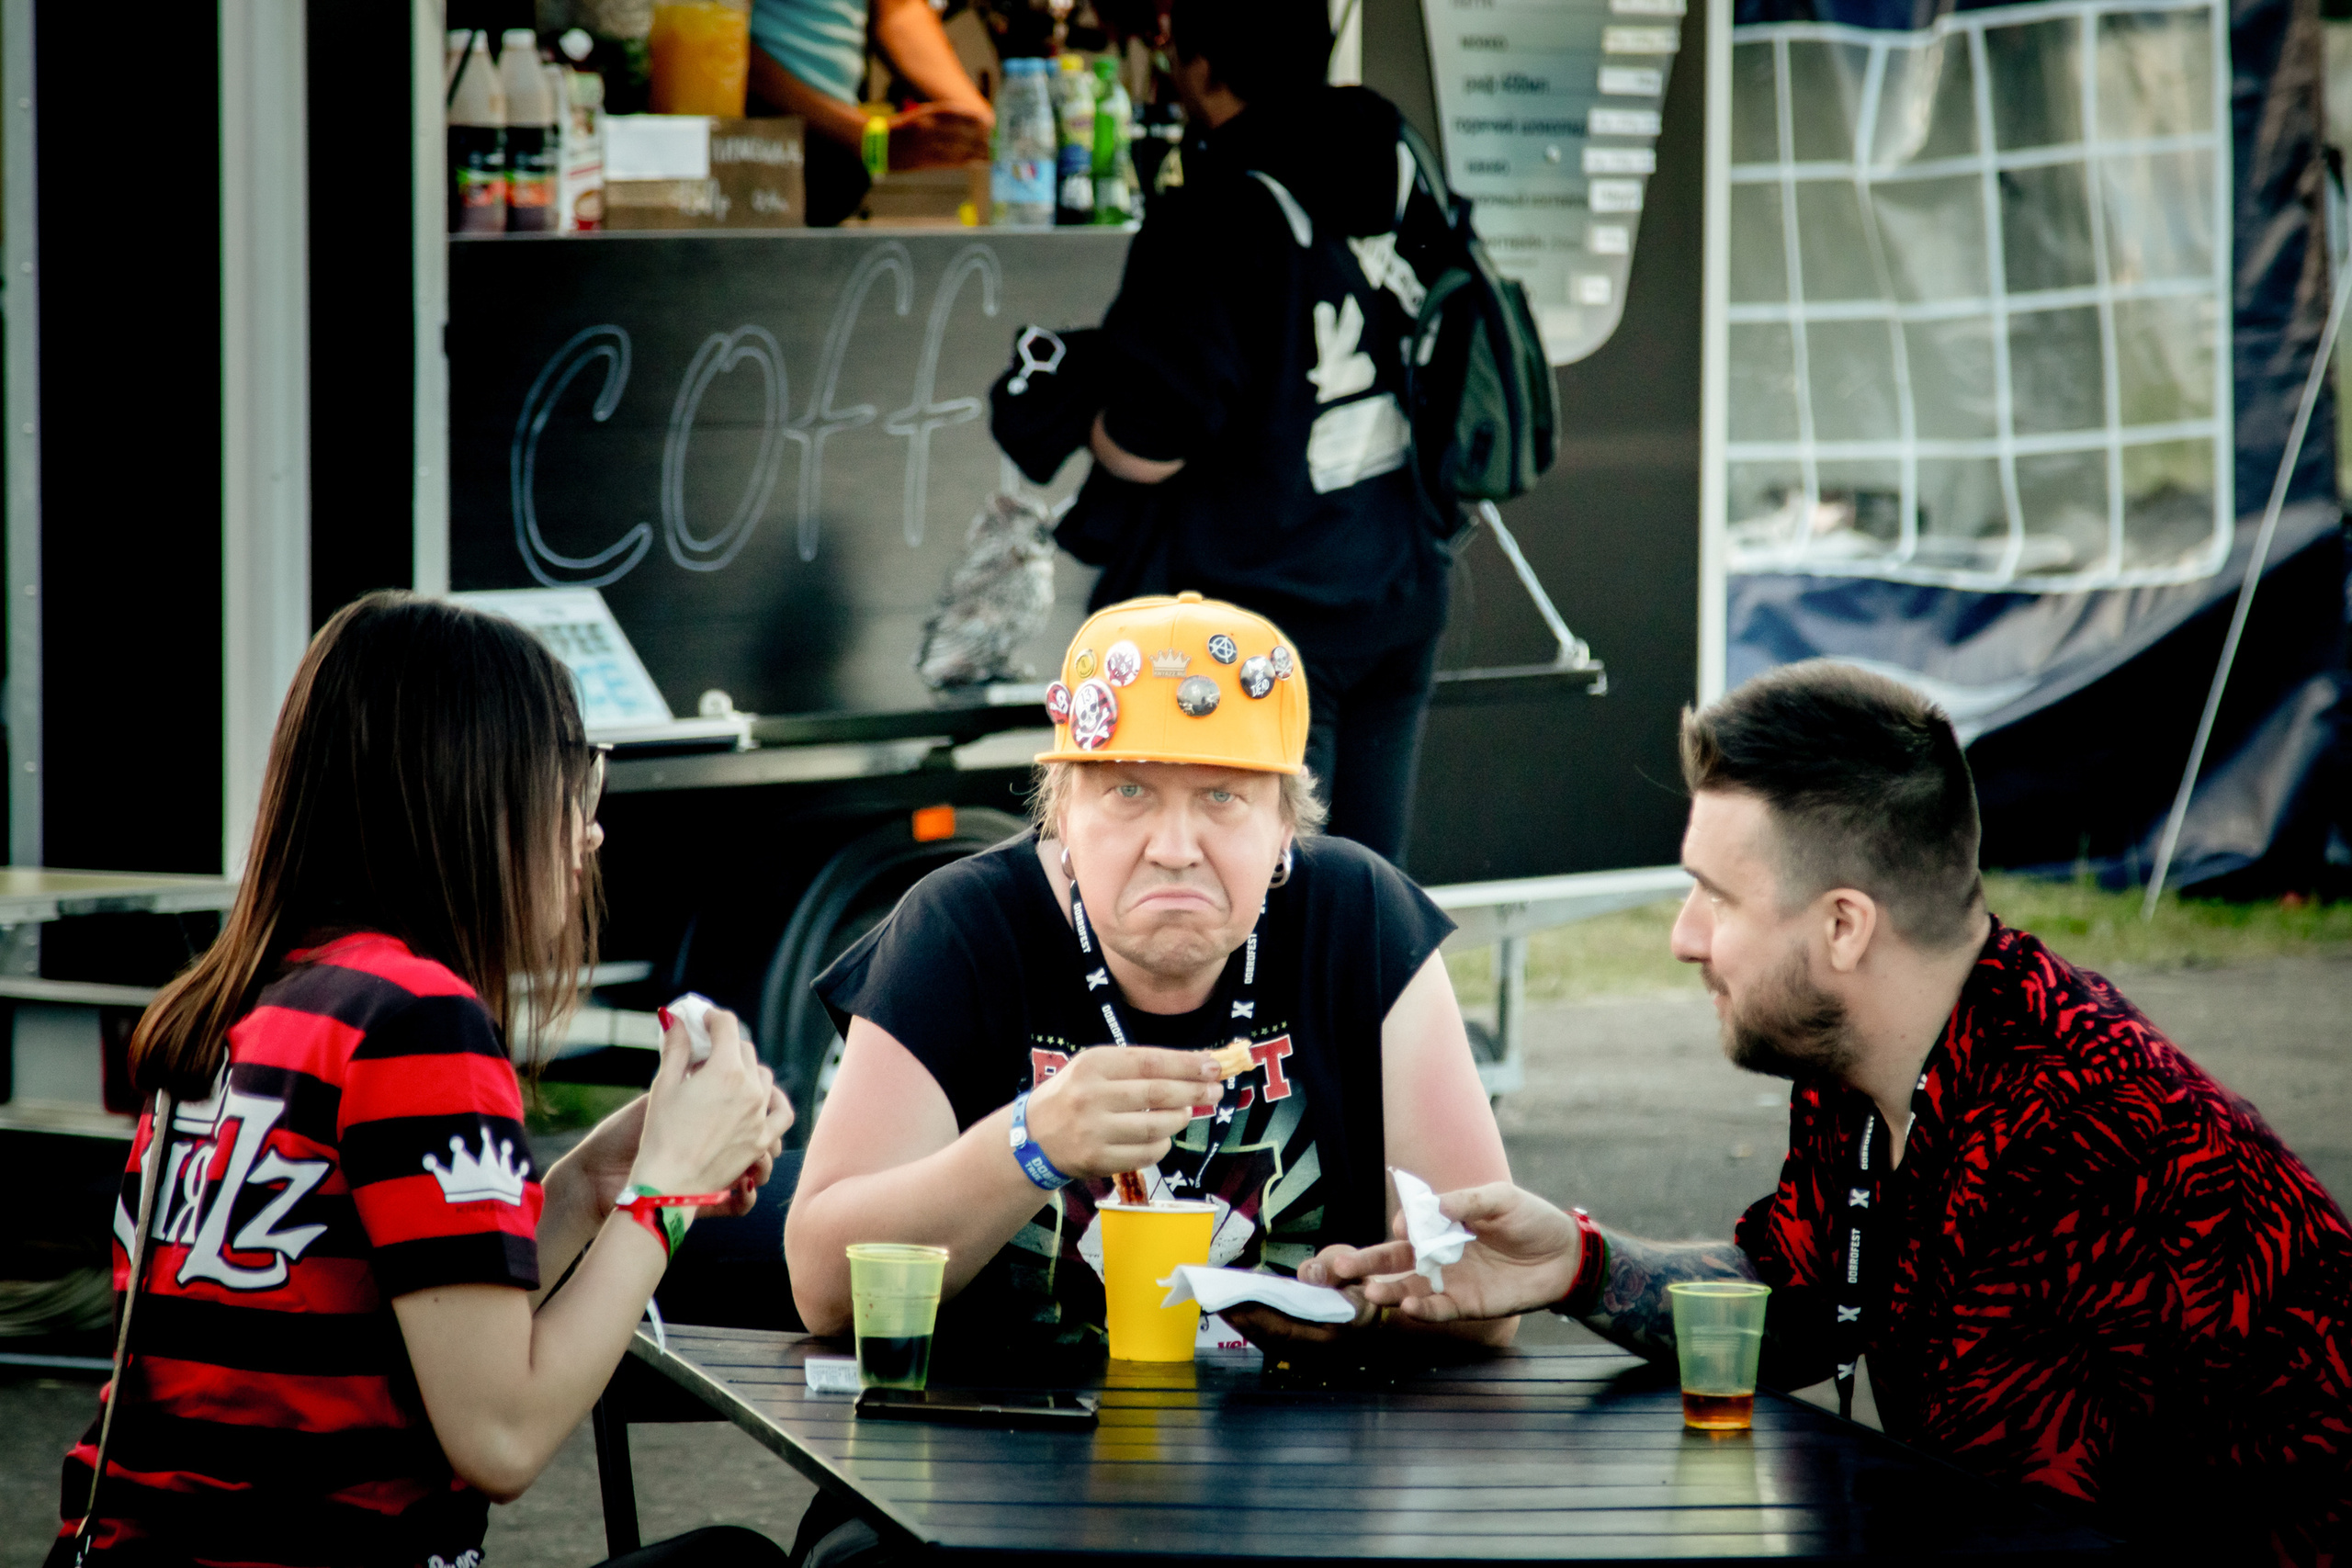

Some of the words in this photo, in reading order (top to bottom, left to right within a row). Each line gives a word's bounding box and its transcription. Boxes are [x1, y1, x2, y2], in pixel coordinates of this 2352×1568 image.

[1081, 688, 1092, 705] 13
[1073, 901, 1091, 953] DOBROFEST
[1102, 1004, 1127, 1047] DOBROFES
[1244, 933, 1258, 985] DOBROFEST
[1860, 1115, 1874, 1170] DOBROFEST
[1848, 1228, 1860, 1284] DOBROFEST
